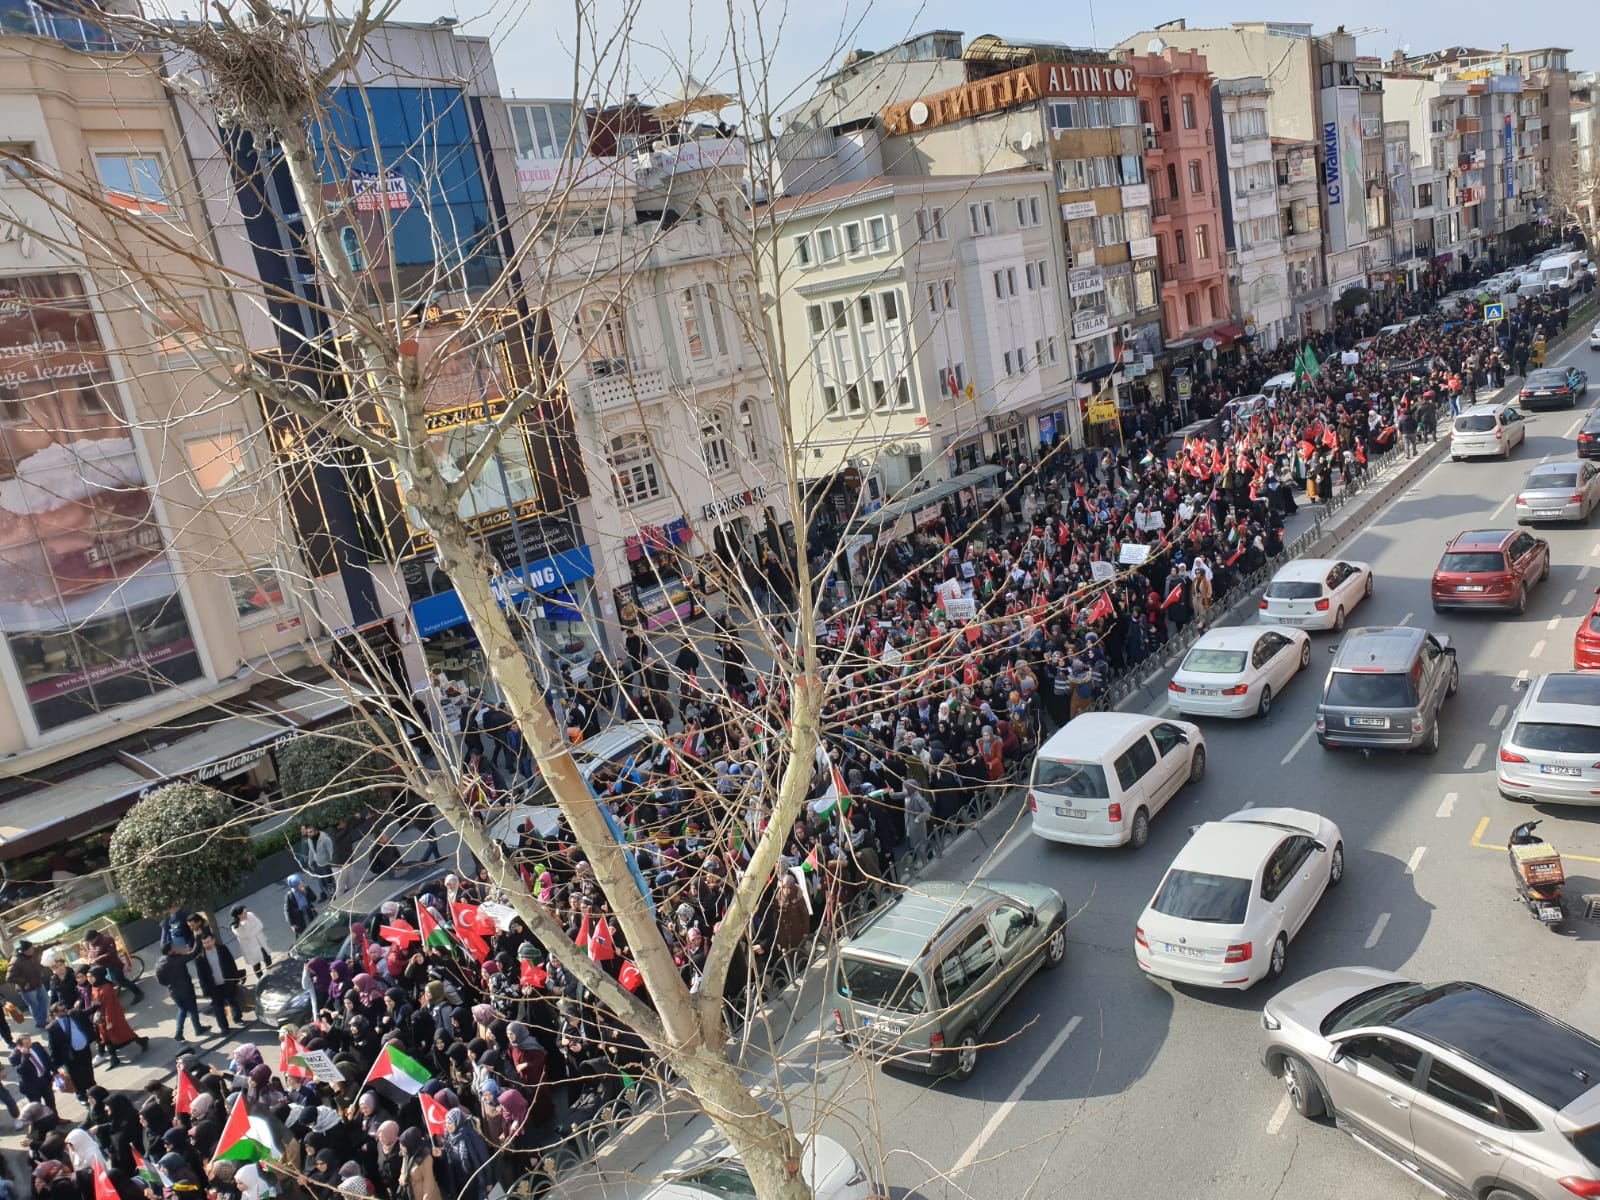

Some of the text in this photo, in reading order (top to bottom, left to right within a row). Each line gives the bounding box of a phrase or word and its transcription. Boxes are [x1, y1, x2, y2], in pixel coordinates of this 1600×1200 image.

[1328, 185, 1340, 205] LC
[1071, 276, 1101, 292] EMLAK
[1076, 316, 1106, 333] EMLAK
[33, 359, 99, 381] lezzet
